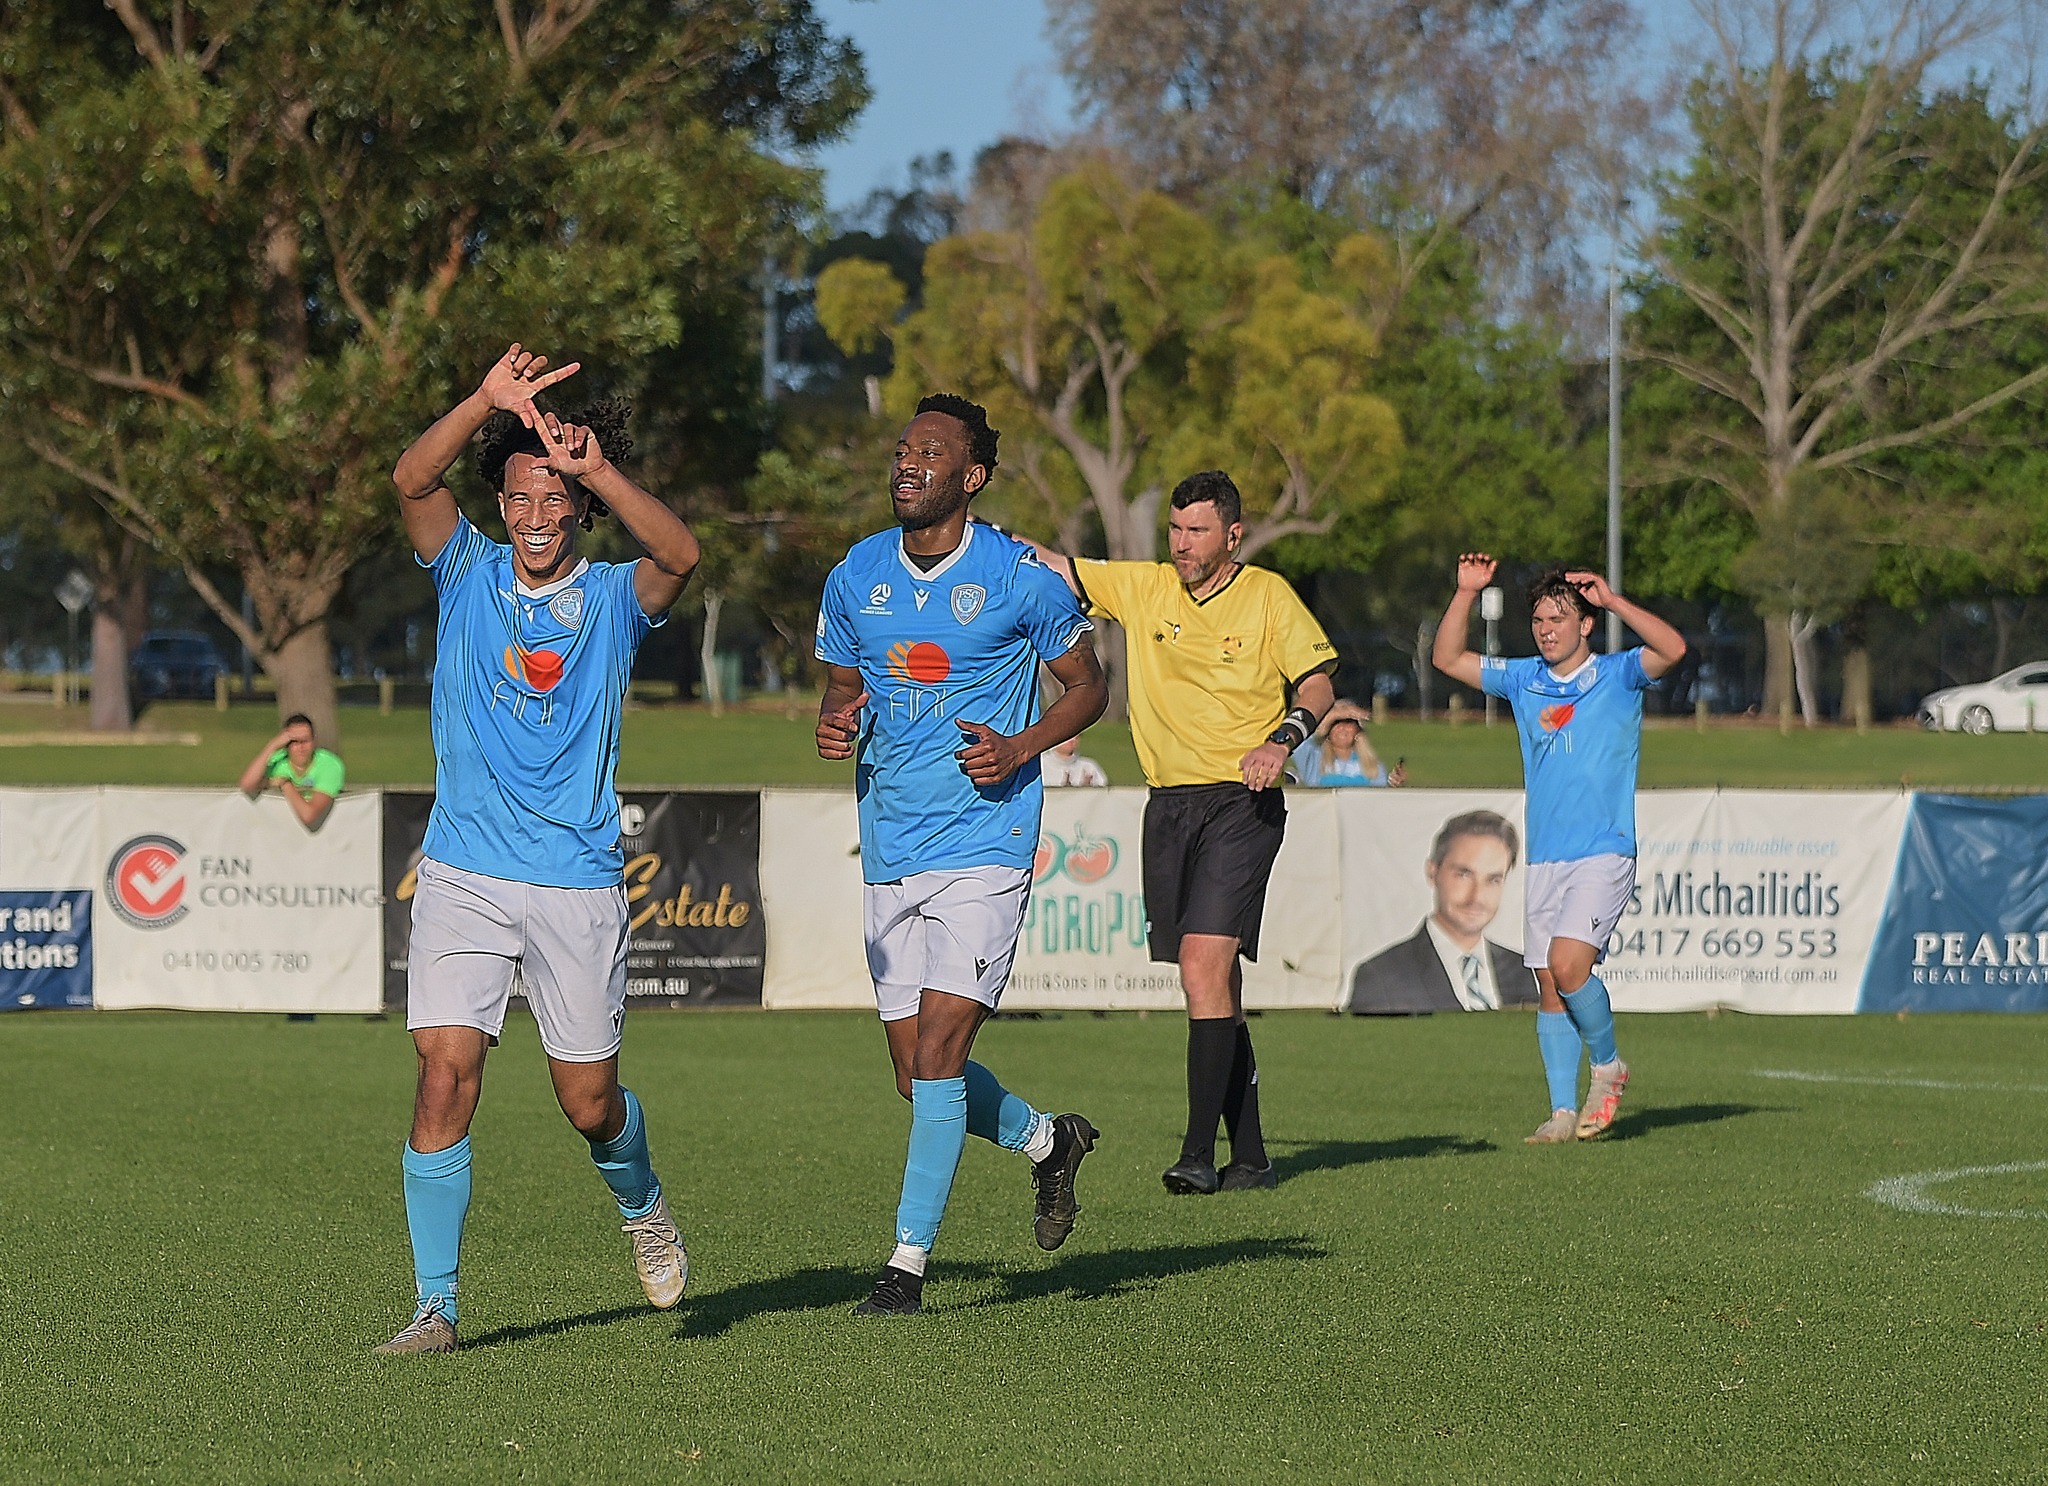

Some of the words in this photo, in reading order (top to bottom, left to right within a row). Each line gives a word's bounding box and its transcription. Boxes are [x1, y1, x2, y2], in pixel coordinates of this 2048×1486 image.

[200, 857, 251, 876] FAN
[199, 886, 378, 908] CONSULTING
[1652, 871, 1841, 918] Michailidis
[1607, 927, 1691, 958] 0417
[1701, 927, 1764, 958] 669
[1774, 927, 1838, 959] 553
[162, 951, 217, 972] 0410
[270, 951, 311, 974] 780
[1094, 972, 1107, 989] in
[1912, 968, 1971, 985] REAL
